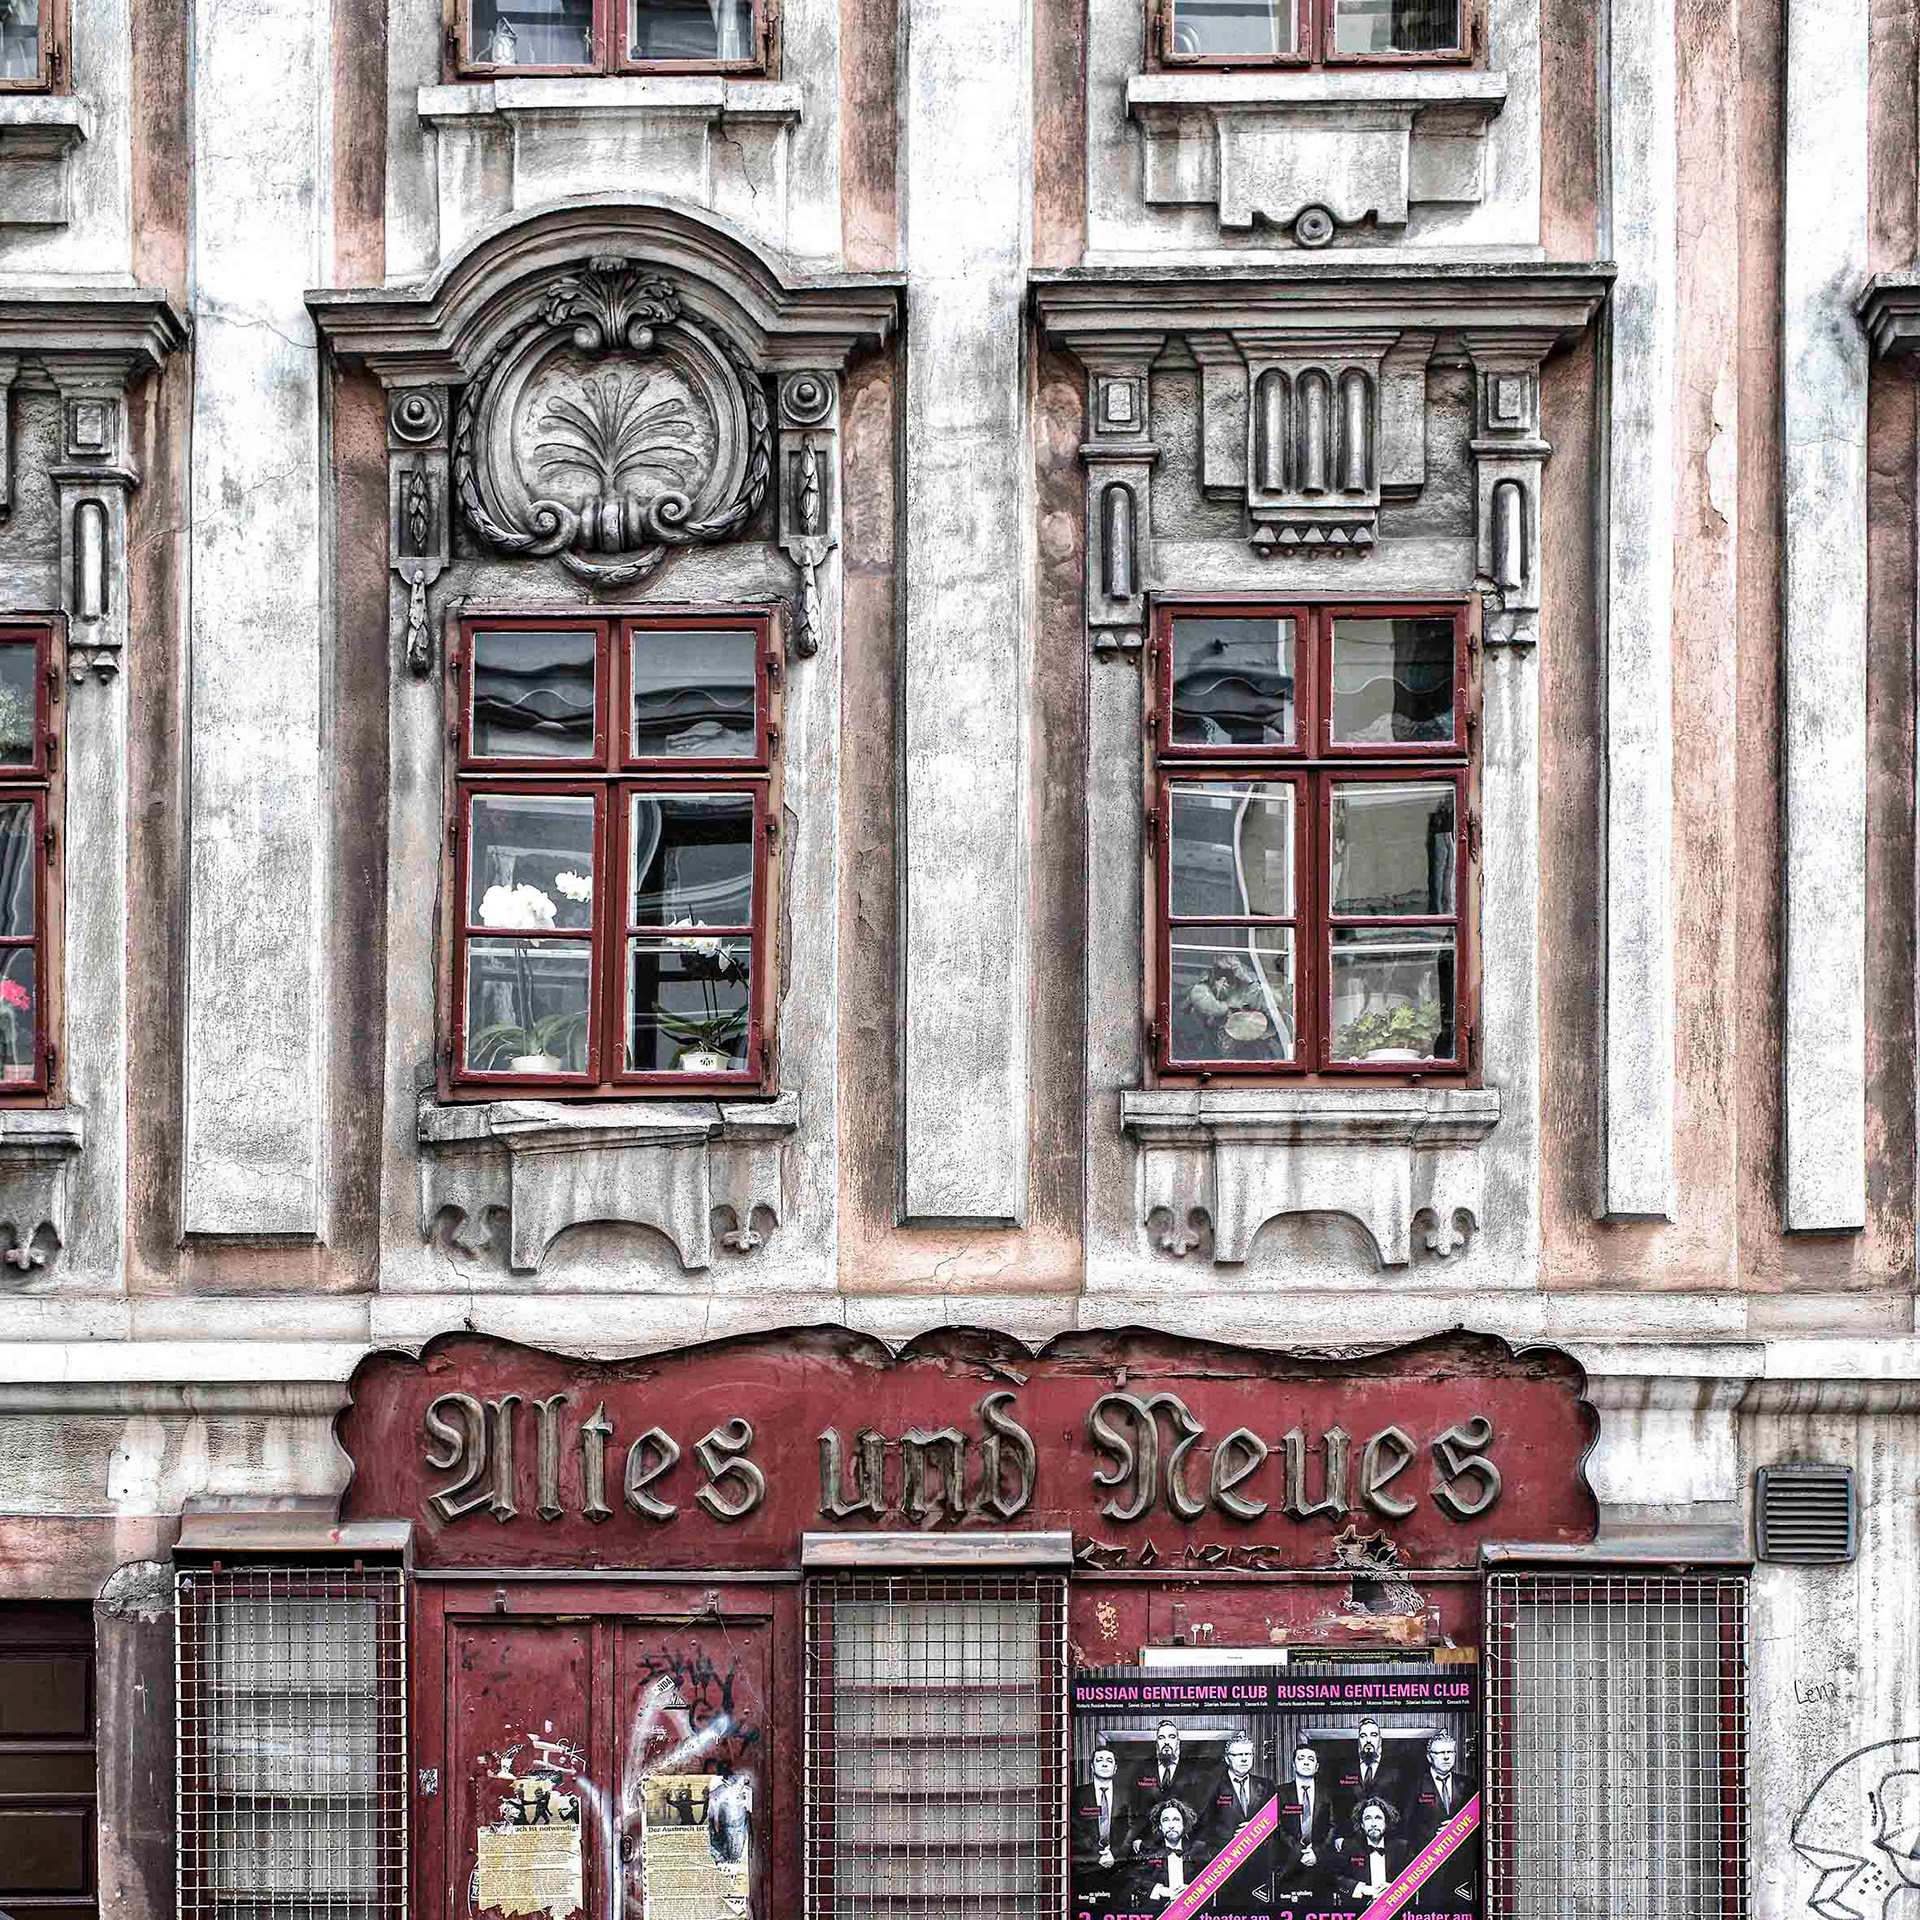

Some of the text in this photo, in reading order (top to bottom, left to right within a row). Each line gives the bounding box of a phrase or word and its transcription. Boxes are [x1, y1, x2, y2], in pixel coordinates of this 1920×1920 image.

[424, 1391, 1502, 1523] Altes und Neues
[1076, 1685, 1268, 1700] RUSSIAN GENTLEMEN CLUB
[1277, 1683, 1470, 1698] RUSSIAN GENTLEMEN CLUB
[1183, 1816, 1271, 1908] FROM RUSSIA WITH LOVE
[1385, 1814, 1474, 1907] FROM RUSSIA WITH LOVE
